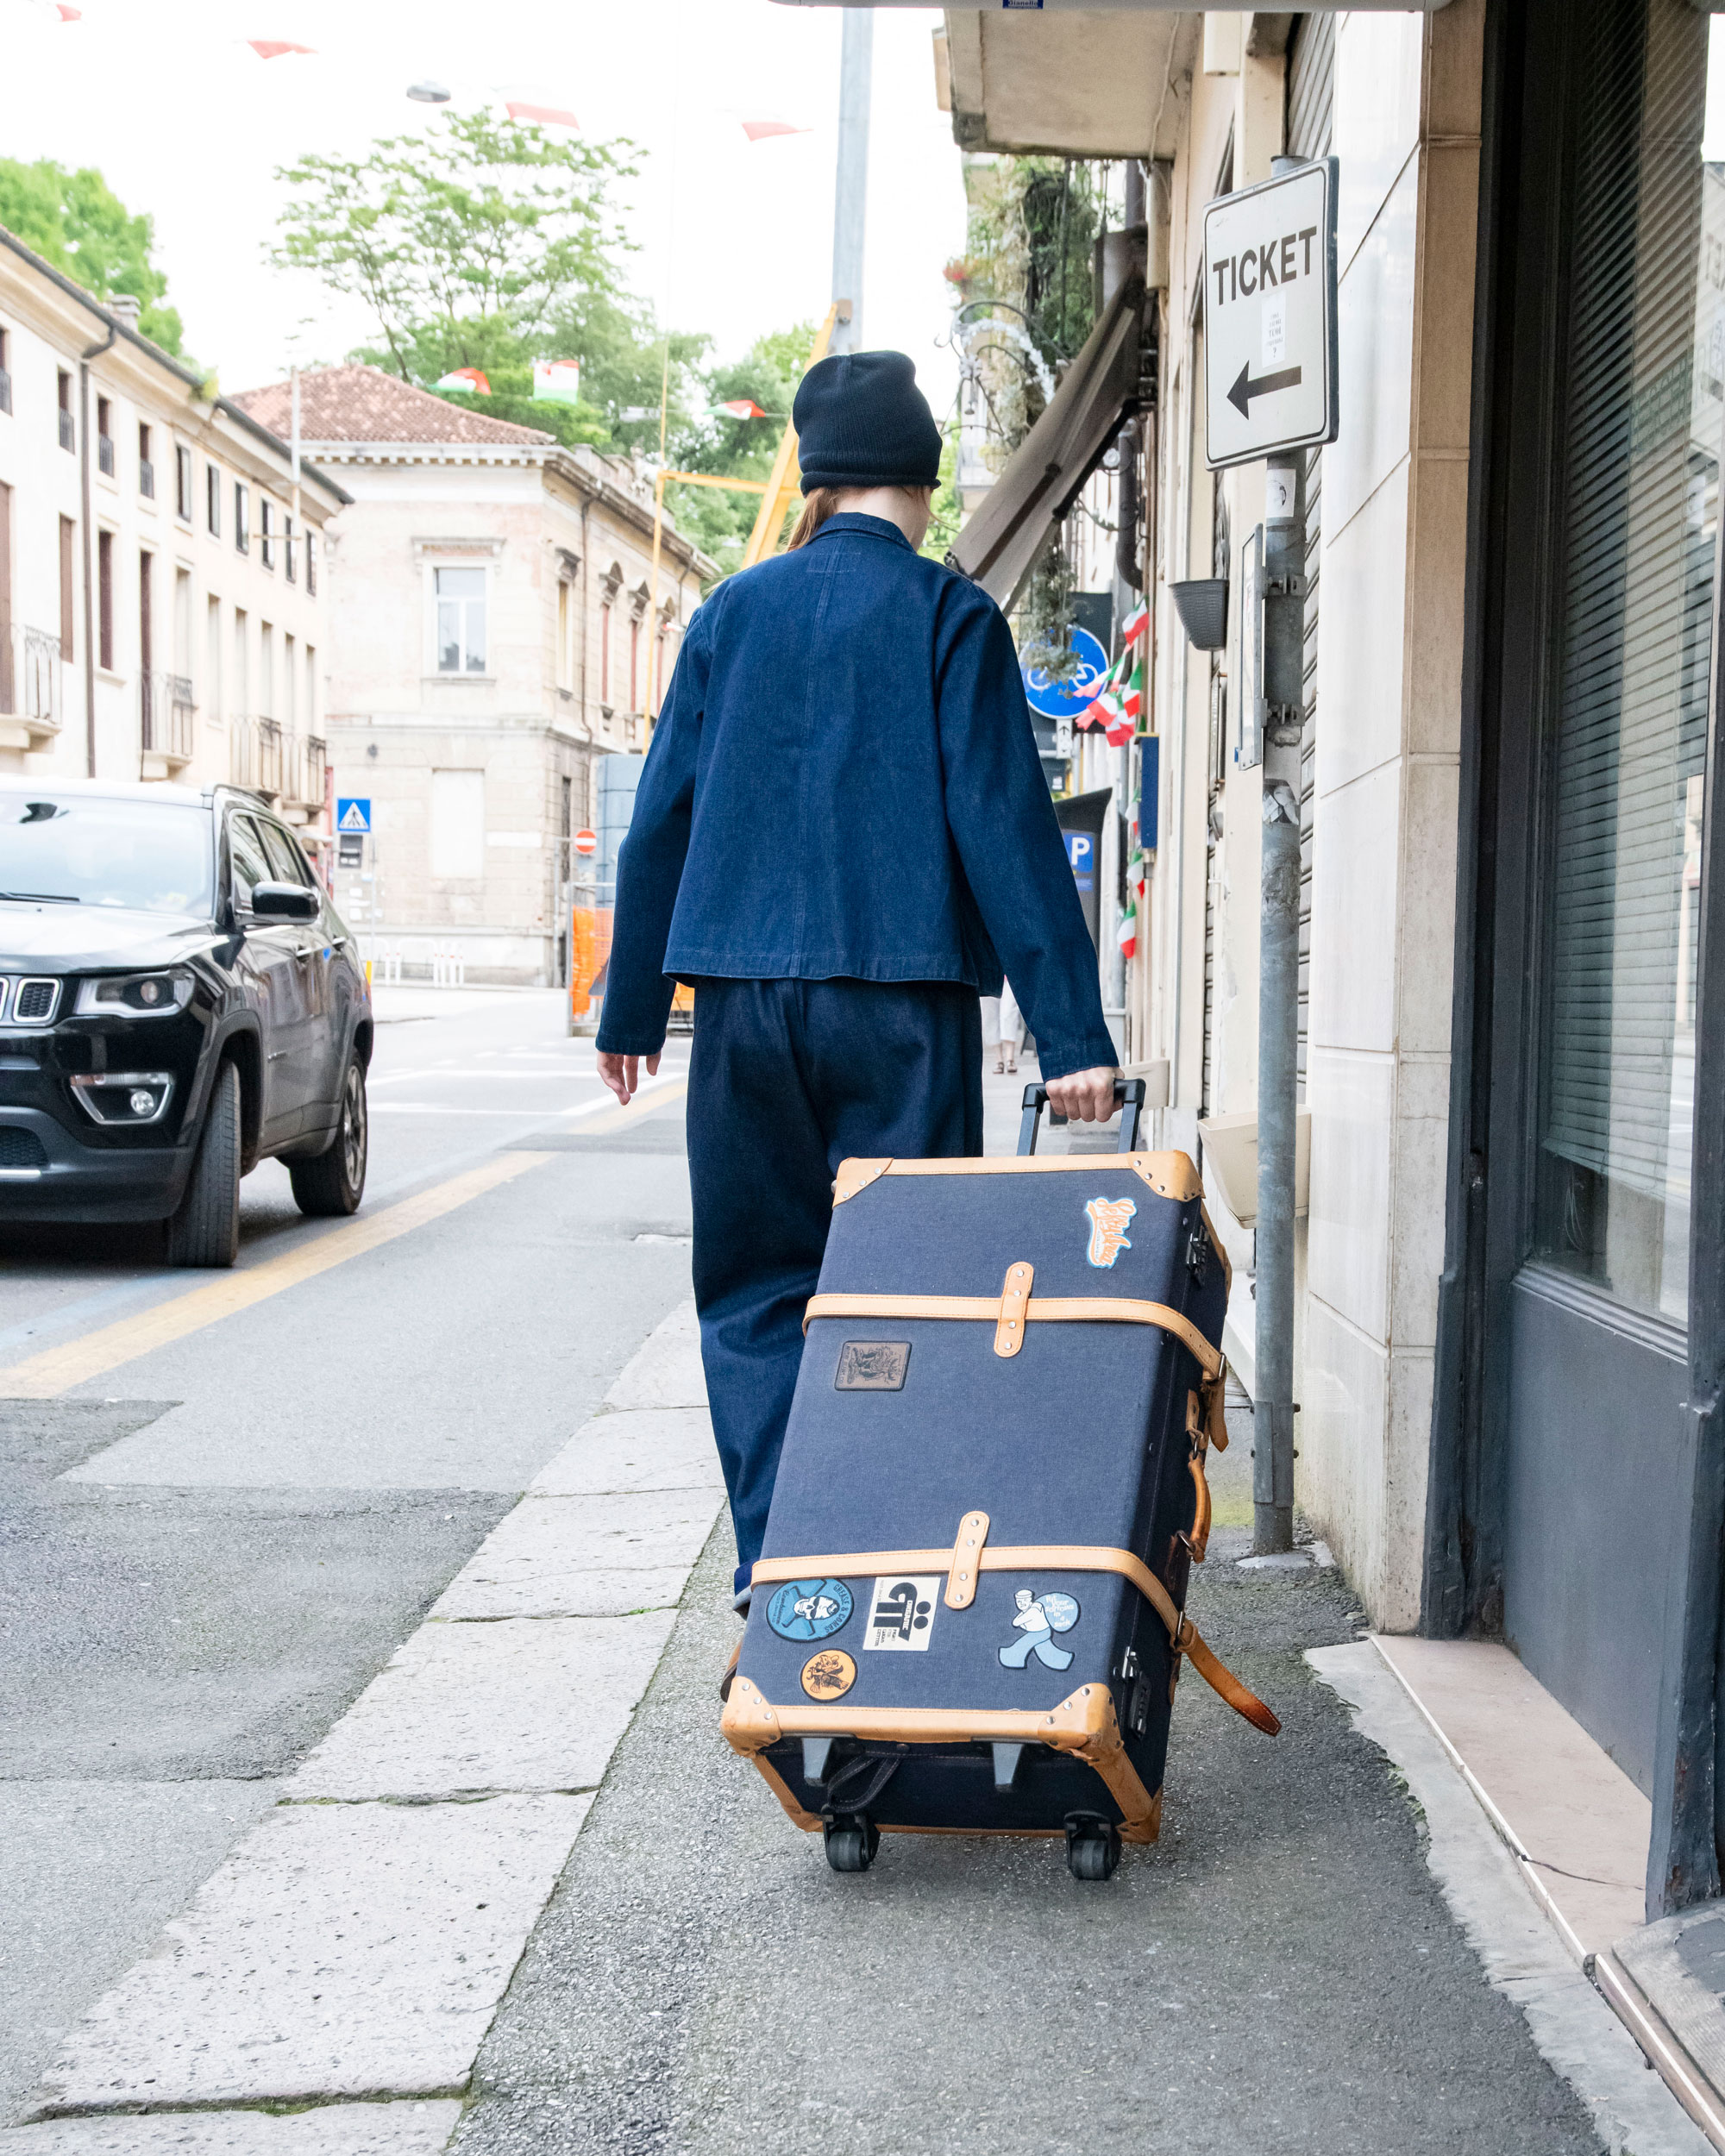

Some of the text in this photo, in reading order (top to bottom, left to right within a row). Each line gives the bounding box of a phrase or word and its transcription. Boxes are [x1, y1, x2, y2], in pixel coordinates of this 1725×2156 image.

[1213, 226, 1317, 306] TICKET
[1071, 837, 1090, 866] P
[832, 1583, 850, 1606] GREASE
[825, 1614, 845, 1633] COMBS
